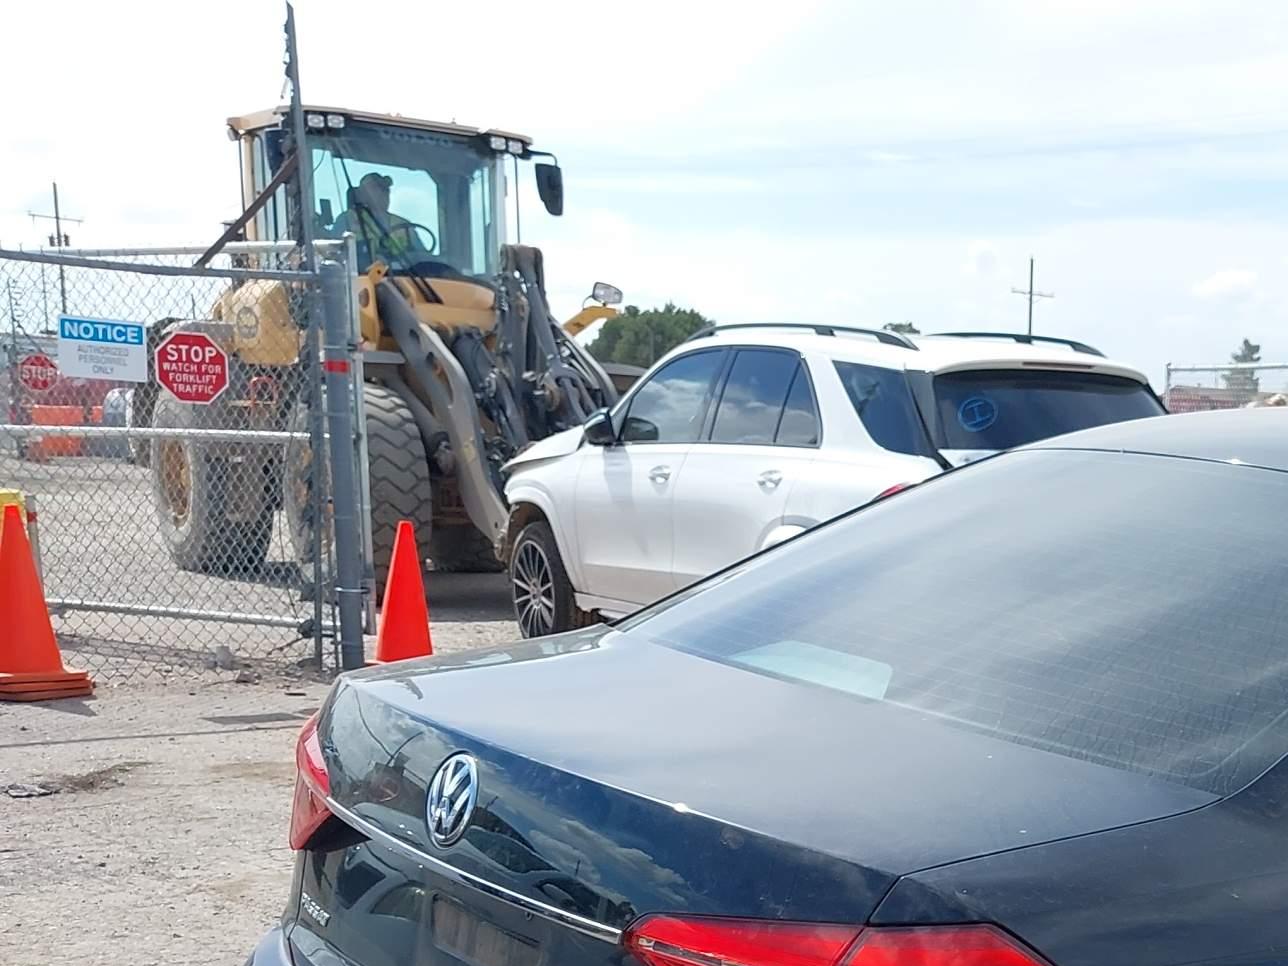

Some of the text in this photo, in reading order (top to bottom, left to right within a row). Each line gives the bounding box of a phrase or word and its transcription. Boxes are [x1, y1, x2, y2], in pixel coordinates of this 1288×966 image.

[64, 321, 140, 343] NOTICE
[166, 344, 217, 363] STOP
[22, 365, 55, 381] STOP
[92, 365, 114, 374] ONLY
[162, 362, 222, 375] WATCH FOR
[168, 373, 217, 384] FORKLIFT
[172, 383, 214, 395] TRAFFIC
